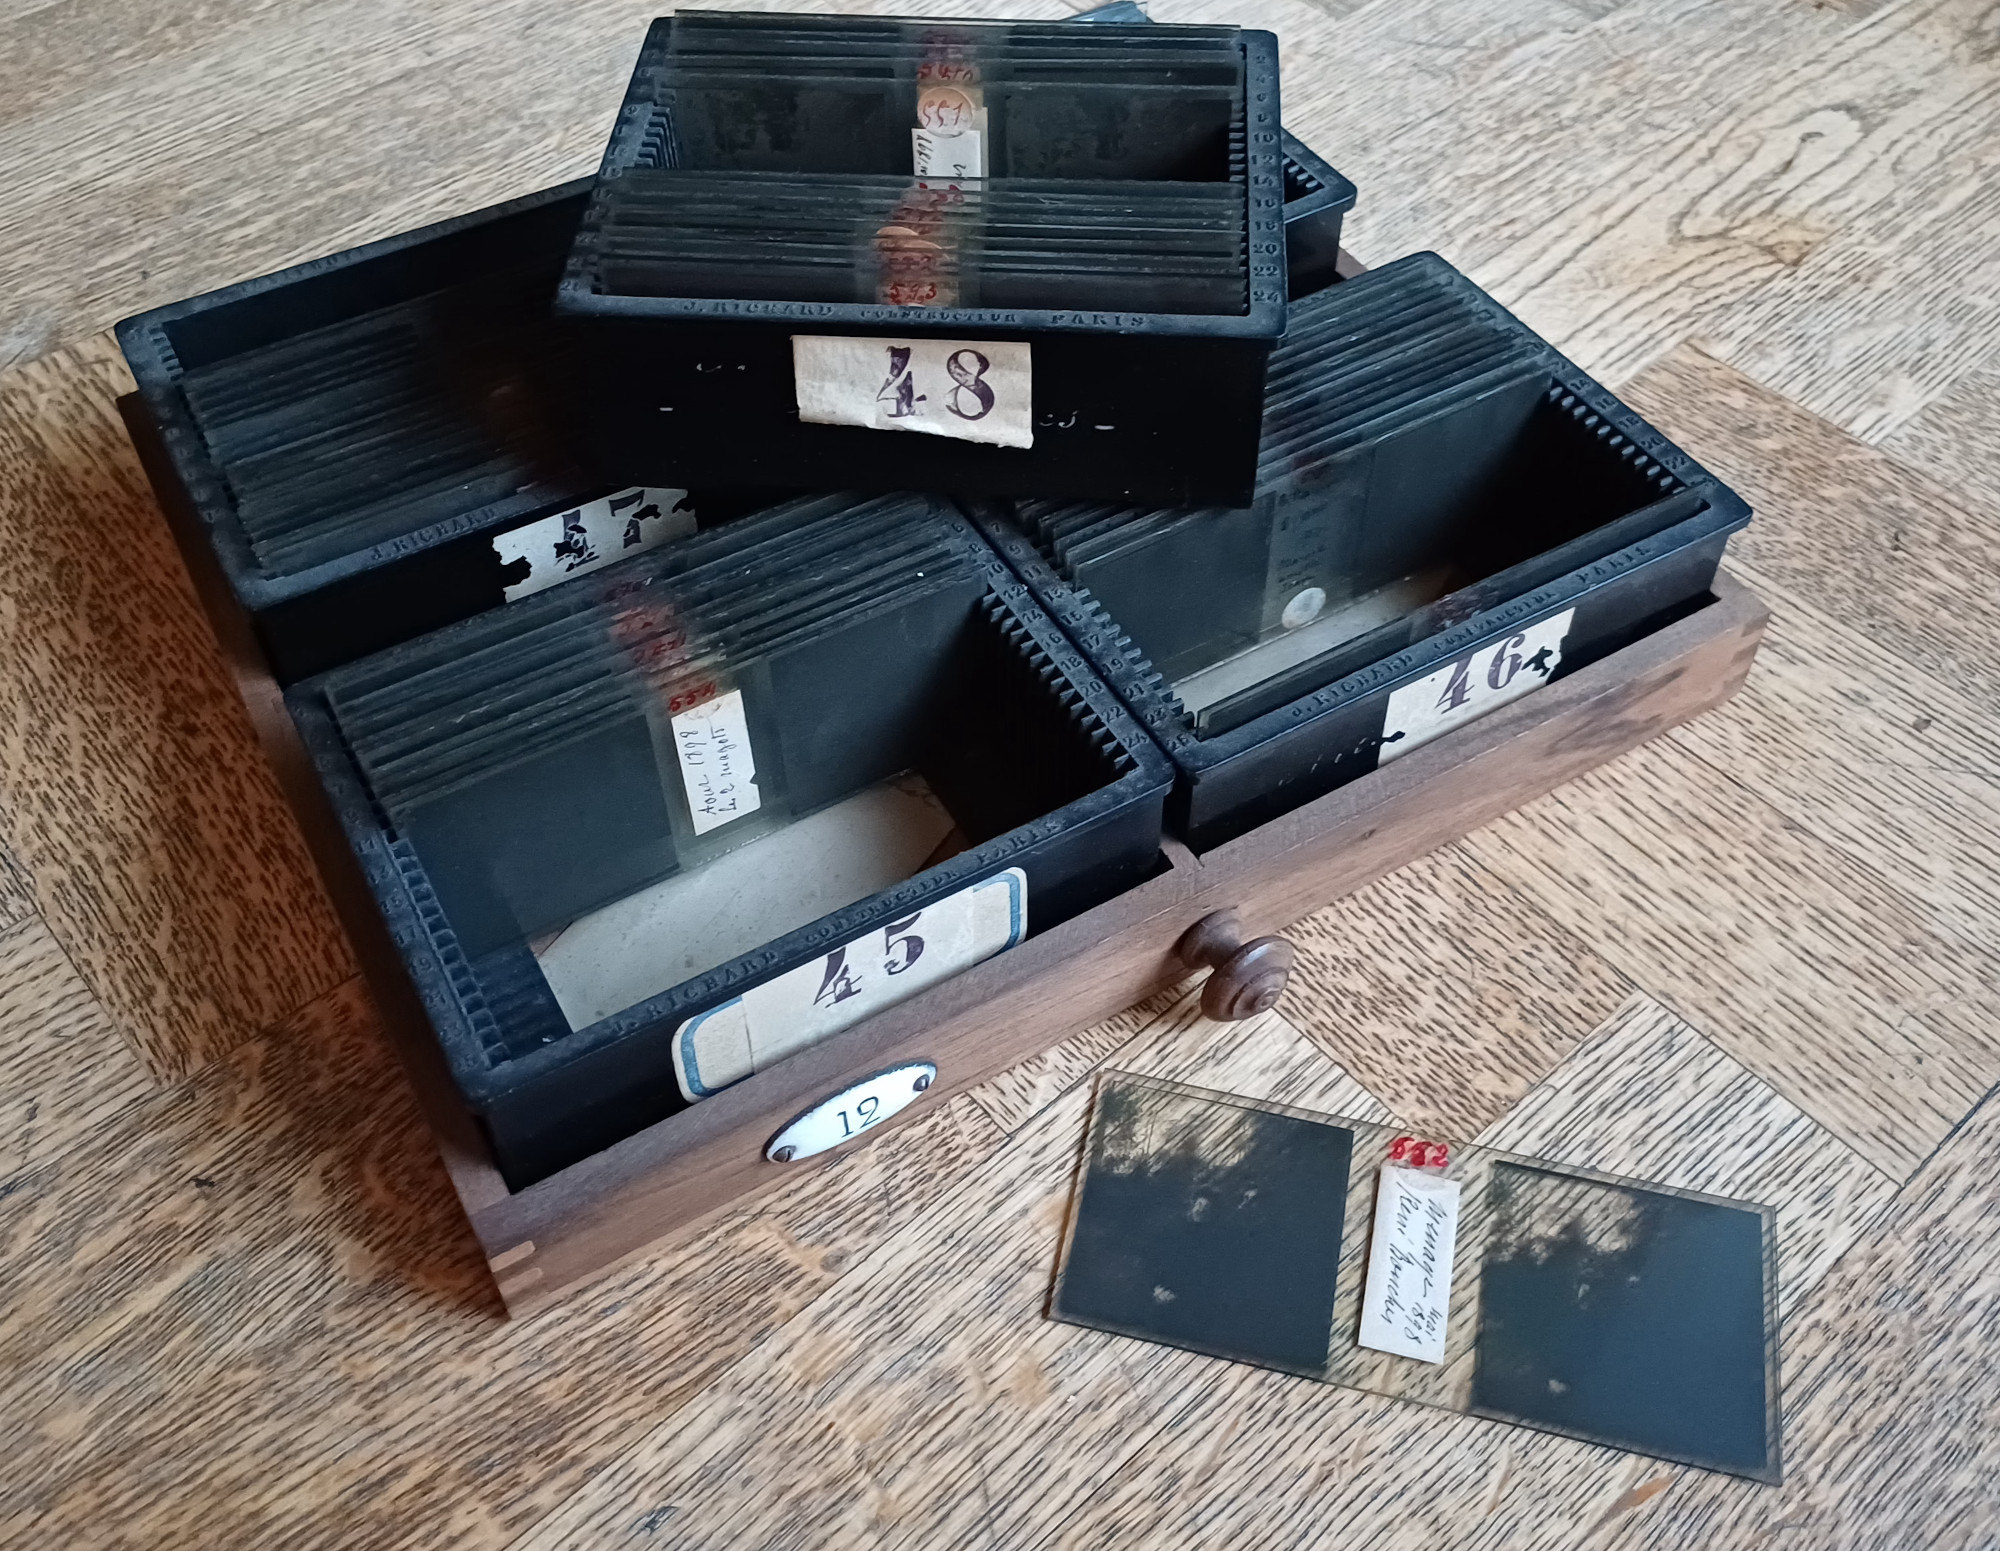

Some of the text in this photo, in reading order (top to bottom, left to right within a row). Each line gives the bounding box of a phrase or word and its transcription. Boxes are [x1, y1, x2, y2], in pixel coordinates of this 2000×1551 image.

[1254, 133, 1274, 144] 10
[1252, 155, 1275, 166] 12
[1253, 175, 1273, 186] 14
[1253, 243, 1277, 254] 20
[1253, 266, 1278, 277] 22
[712, 302, 832, 317] RICHARD
[1051, 313, 1147, 327] PARIS
[1253, 291, 1280, 302] 24
[876, 346, 995, 421] 48
[394, 508, 496, 552] RICHARD
[1313, 653, 1413, 707] RICHARD
[1435, 633, 1526, 714] 46
[679, 730, 708, 766] 1898
[646, 951, 777, 1019] RICHARD
[977, 818, 1064, 865] PARIS
[813, 912, 925, 1008] 45
[837, 1096, 881, 1138] 12
